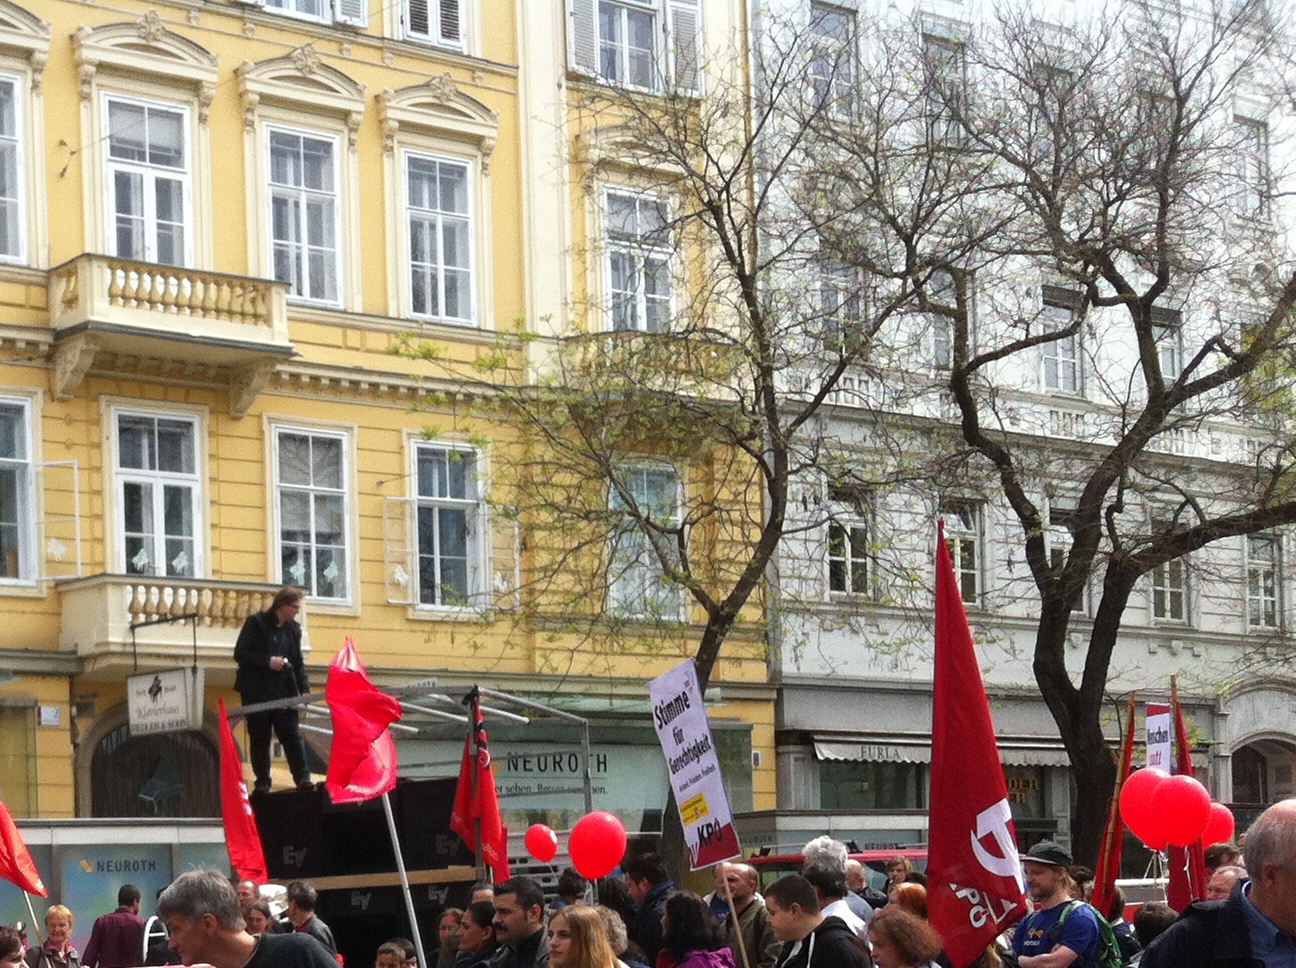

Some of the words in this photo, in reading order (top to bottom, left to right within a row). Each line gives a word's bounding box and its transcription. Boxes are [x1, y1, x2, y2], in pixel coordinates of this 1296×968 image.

[653, 690, 691, 730] Stimme
[671, 726, 685, 747] für
[507, 751, 608, 773] NEUROH
[668, 733, 712, 775] Gerechtigkeit
[860, 745, 901, 760] FURLA
[96, 859, 156, 873] NEUROTH
